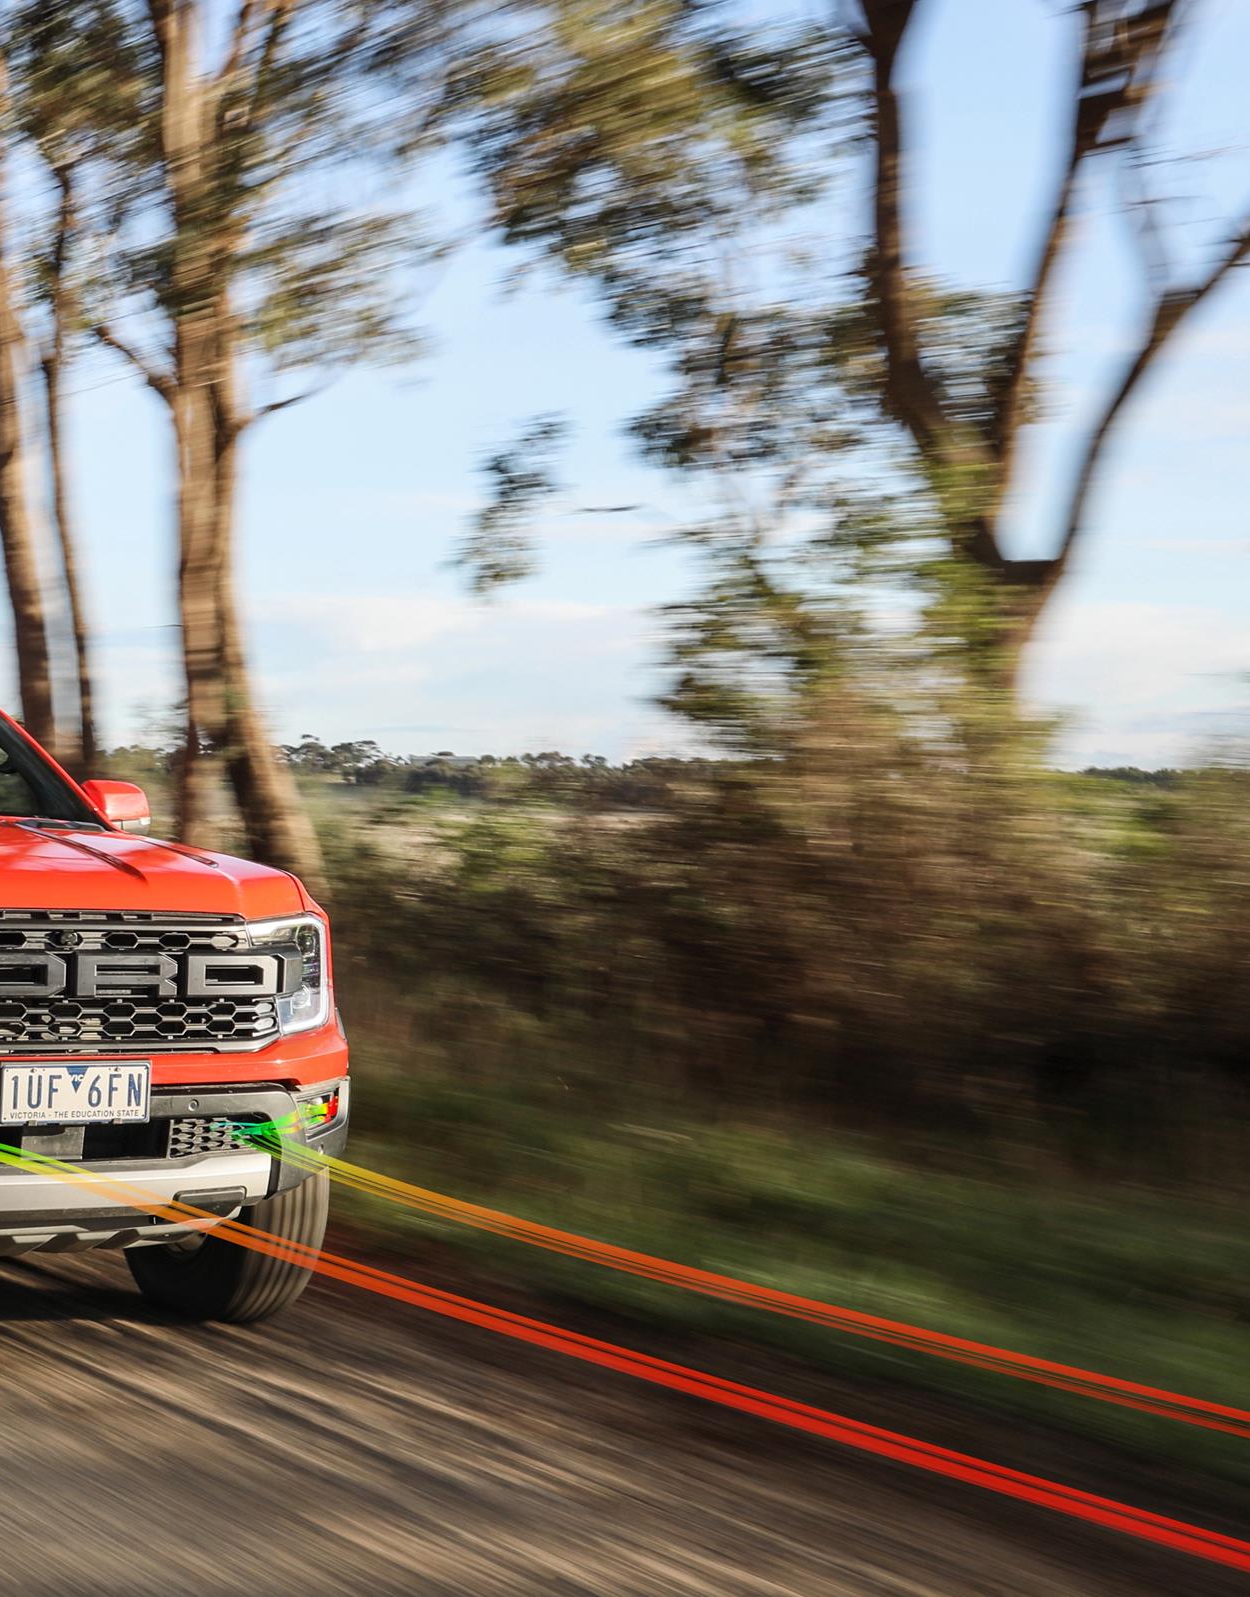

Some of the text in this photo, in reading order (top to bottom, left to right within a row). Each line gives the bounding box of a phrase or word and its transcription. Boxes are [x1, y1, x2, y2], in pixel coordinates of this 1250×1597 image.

[11, 1073, 142, 1110] 1UF 6FN
[10, 1111, 46, 1119] VICTORIA
[71, 1110, 114, 1118] EDUCATION
[116, 1109, 139, 1117] STATE
